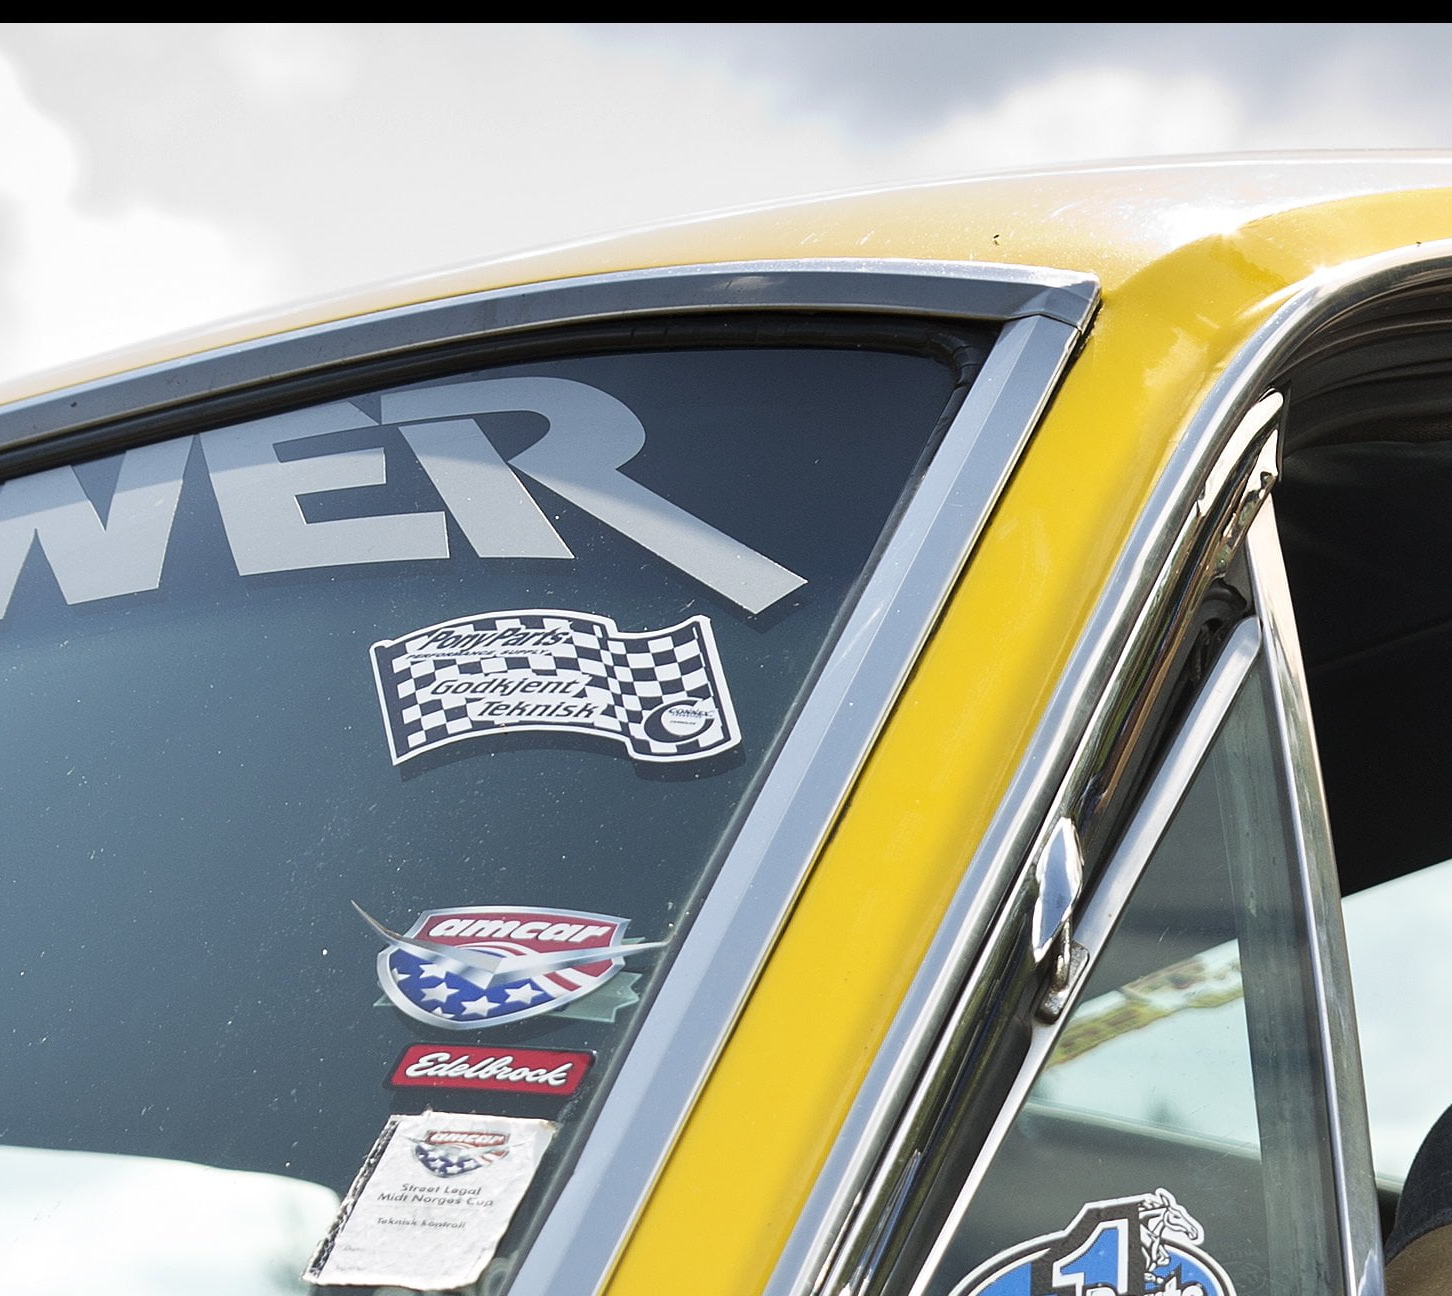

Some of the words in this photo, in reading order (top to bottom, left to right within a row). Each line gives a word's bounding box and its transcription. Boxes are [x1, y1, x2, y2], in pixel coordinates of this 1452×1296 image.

[419, 625, 570, 651] PonyParts
[406, 649, 495, 660] PERFORMANCE
[499, 649, 552, 657] SUPPLY
[431, 678, 580, 697] Godkjent
[478, 701, 599, 717] Teknisk
[429, 917, 610, 943] amcar
[405, 1052, 568, 1086] Edelbrock
[401, 1183, 440, 1193] Street
[444, 1186, 482, 1196] Legal
[377, 1193, 408, 1202] Midt
[411, 1194, 462, 1206] Norges
[465, 1197, 494, 1208] Cup
